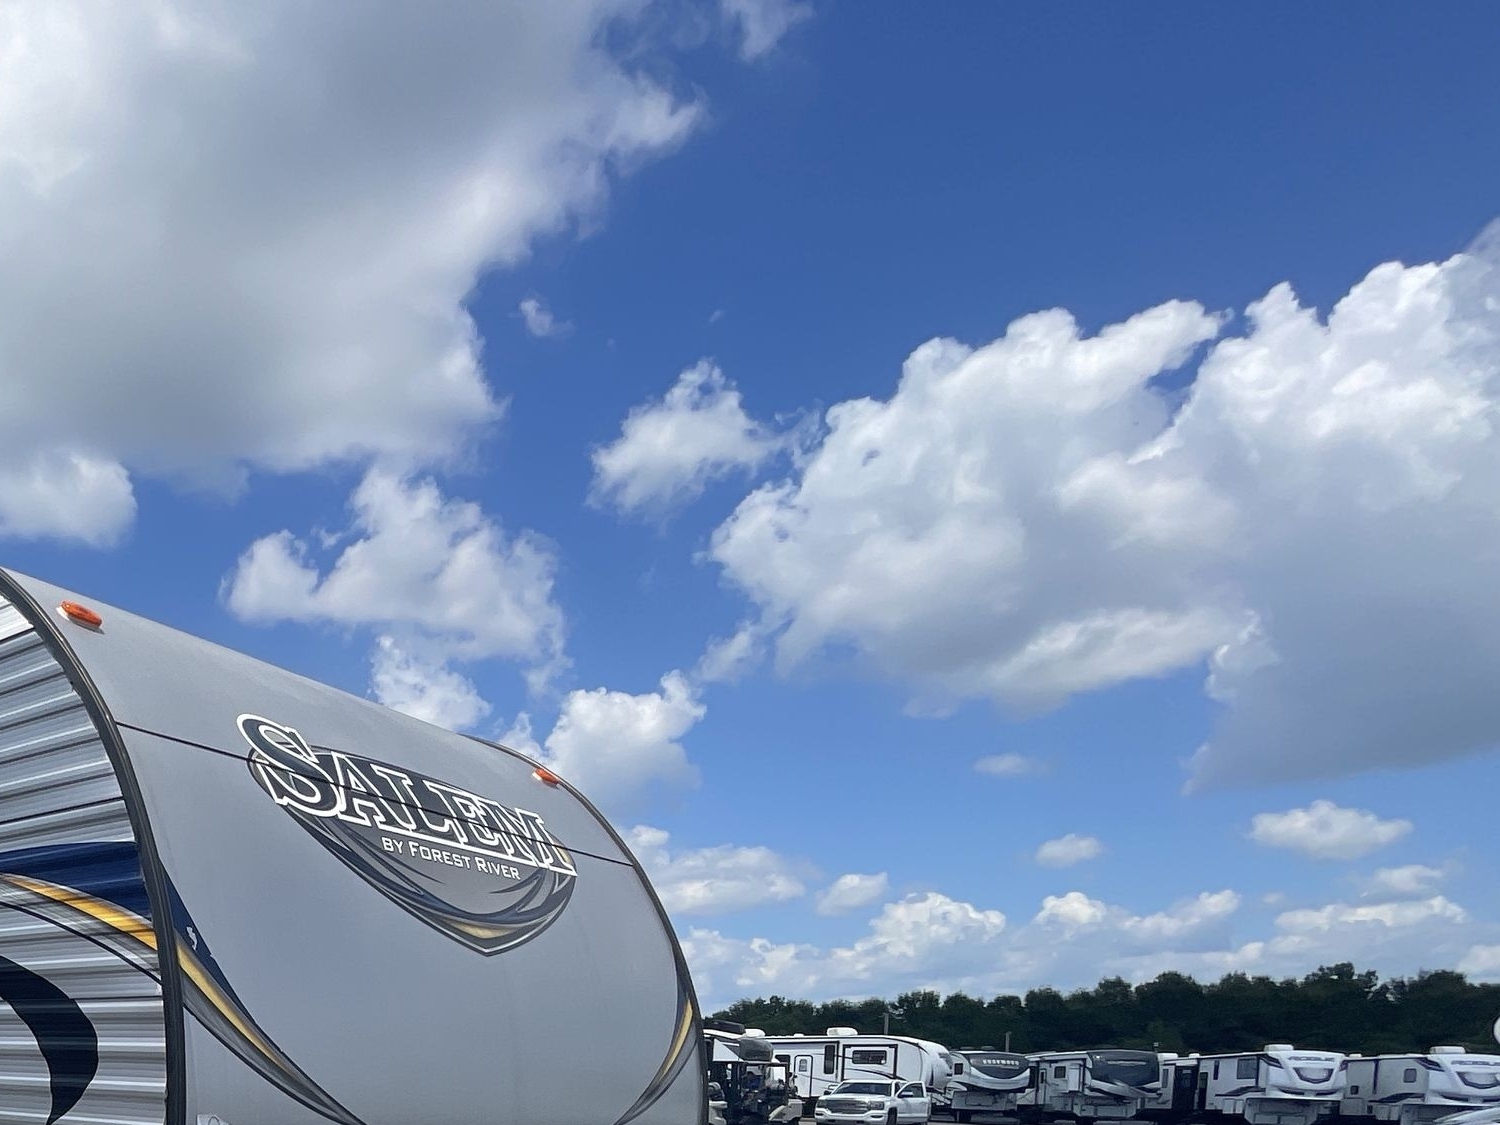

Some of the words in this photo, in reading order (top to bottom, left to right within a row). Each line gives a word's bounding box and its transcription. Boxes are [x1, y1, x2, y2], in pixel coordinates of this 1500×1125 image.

[236, 713, 578, 877] SALEM
[381, 836, 404, 854] BY
[408, 841, 471, 870] FOREST
[474, 856, 521, 880] RIVER
